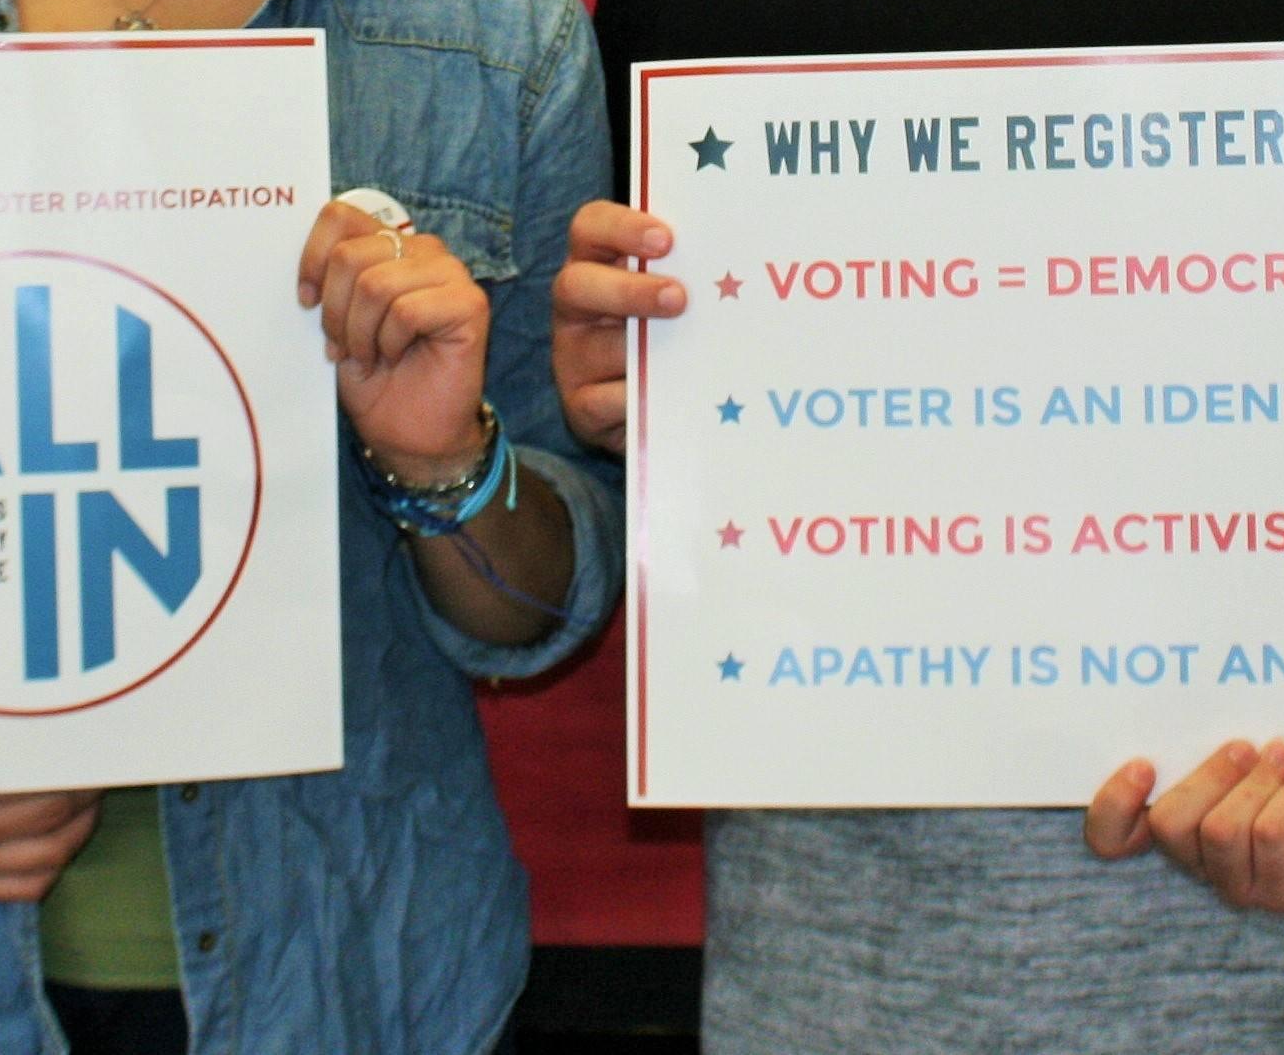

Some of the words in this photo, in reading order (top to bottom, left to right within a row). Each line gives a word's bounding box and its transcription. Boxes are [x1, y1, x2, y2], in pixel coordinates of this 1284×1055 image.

[765, 120, 875, 175] WHY
[904, 117, 980, 172] WE
[75, 185, 295, 211] PARTICIPATION
[766, 259, 978, 300] VOTING
[768, 388, 951, 427] VOTER
[975, 387, 1021, 426] IS
[1041, 386, 1120, 425] AN
[769, 516, 983, 555] VOTING
[1006, 515, 1052, 554] IS
[21, 486, 203, 682] IN
[769, 647, 990, 685] APATHY
[1012, 645, 1058, 685] IS
[1081, 645, 1199, 685] NOT
